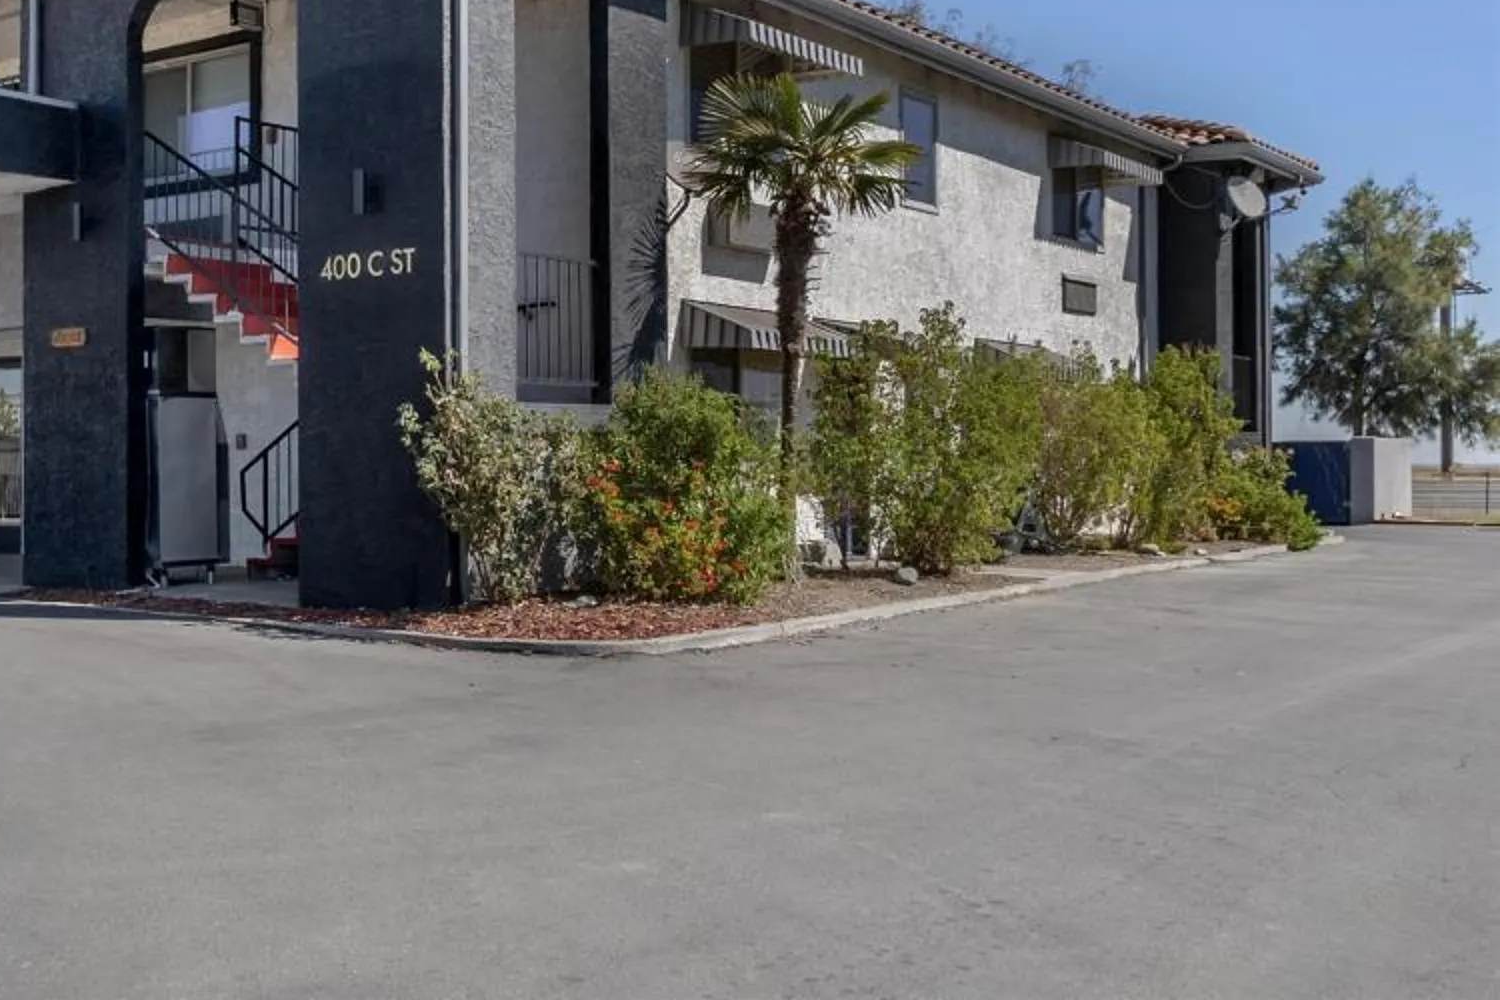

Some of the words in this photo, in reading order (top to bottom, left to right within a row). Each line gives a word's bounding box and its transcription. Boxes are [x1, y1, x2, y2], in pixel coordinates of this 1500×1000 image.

[320, 252, 361, 281] 400
[367, 250, 384, 276] C
[390, 247, 416, 274] ST
